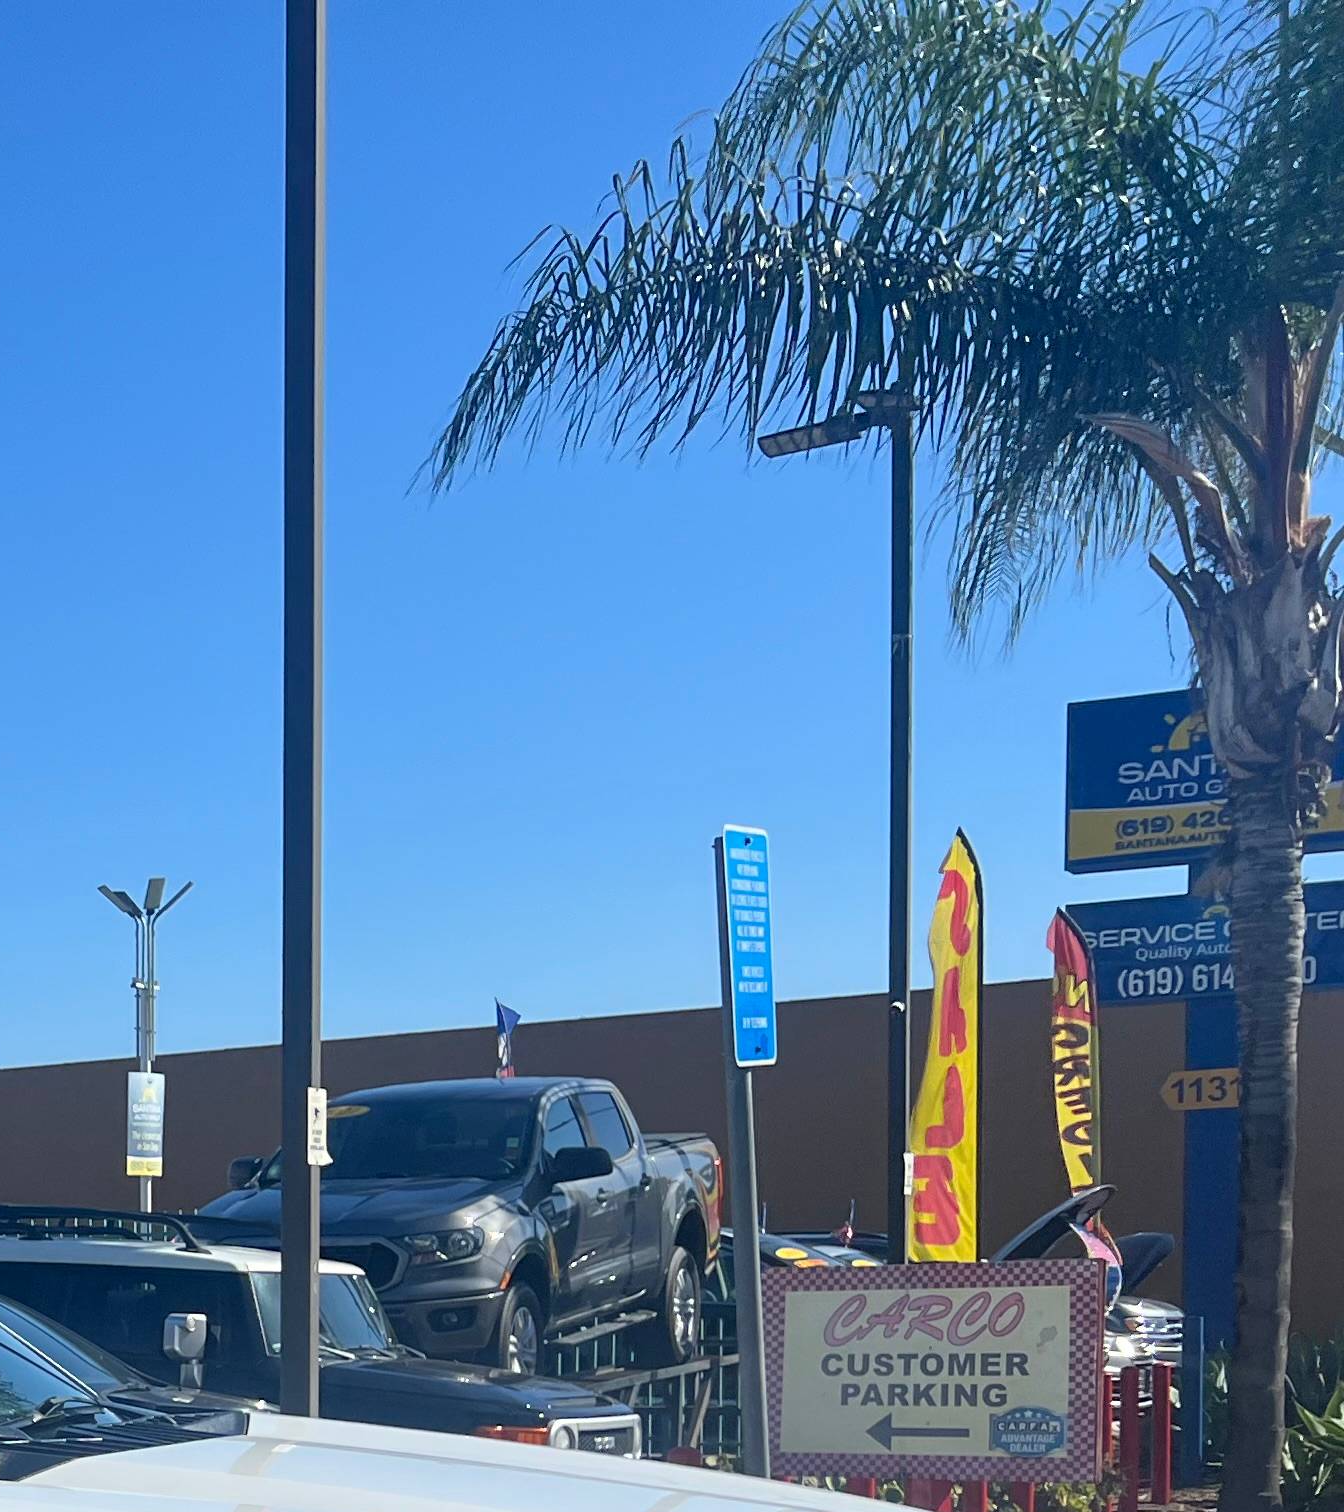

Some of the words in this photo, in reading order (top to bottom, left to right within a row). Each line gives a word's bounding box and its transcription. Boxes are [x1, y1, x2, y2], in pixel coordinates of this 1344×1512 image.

[1117, 754, 1227, 785] SANT
[1128, 781, 1199, 803] AUTO
[1115, 814, 1174, 840] (619)
[1083, 921, 1217, 950] SERVICE
[1135, 946, 1193, 962] Quality
[1118, 965, 1185, 999] (619)
[822, 1290, 1026, 1347] CARCO
[820, 1352, 1031, 1378] CUSTOMER
[840, 1382, 1009, 1408] PARKING
[1000, 1433, 1057, 1443] ADVANTAGE
[1009, 1443, 1046, 1453] DEALER
